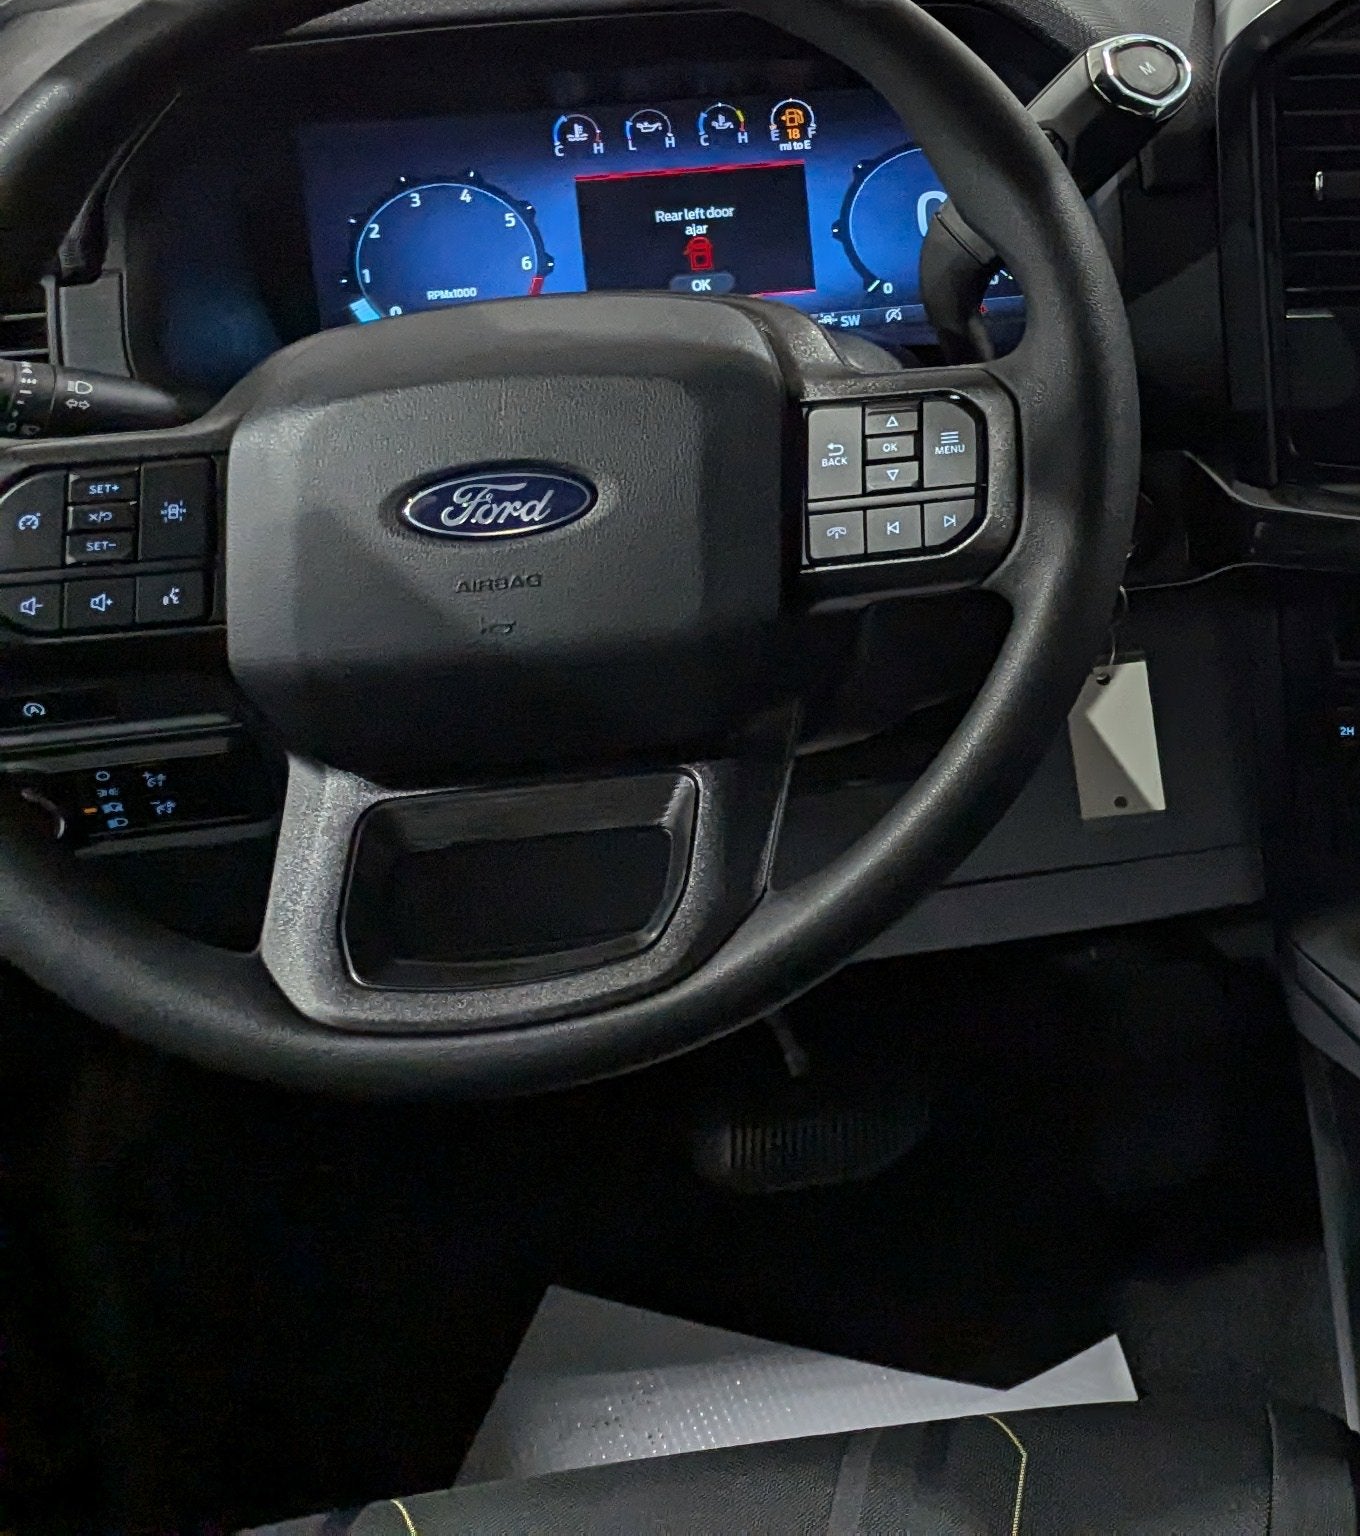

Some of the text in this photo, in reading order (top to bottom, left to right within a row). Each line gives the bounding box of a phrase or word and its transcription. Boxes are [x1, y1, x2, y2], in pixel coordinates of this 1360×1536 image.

[787, 128, 800, 140] 18
[410, 192, 421, 208] 3
[460, 189, 472, 203] 4
[504, 213, 516, 227] 5
[655, 206, 735, 223] Rear left door
[368, 224, 380, 239] 2
[685, 224, 708, 237] ajar
[521, 255, 532, 271] 6
[362, 269, 371, 284] 1
[691, 278, 712, 292] OK
[883, 282, 894, 294] 0
[840, 314, 861, 327] SW
[882, 441, 898, 453] OK
[933, 443, 967, 456] MENU
[820, 454, 849, 468] BACK
[88, 483, 120, 495] SET+
[441, 480, 553, 530] Ford
[453, 571, 543, 596] AIRBAG
[1340, 726, 1355, 736] 2H
